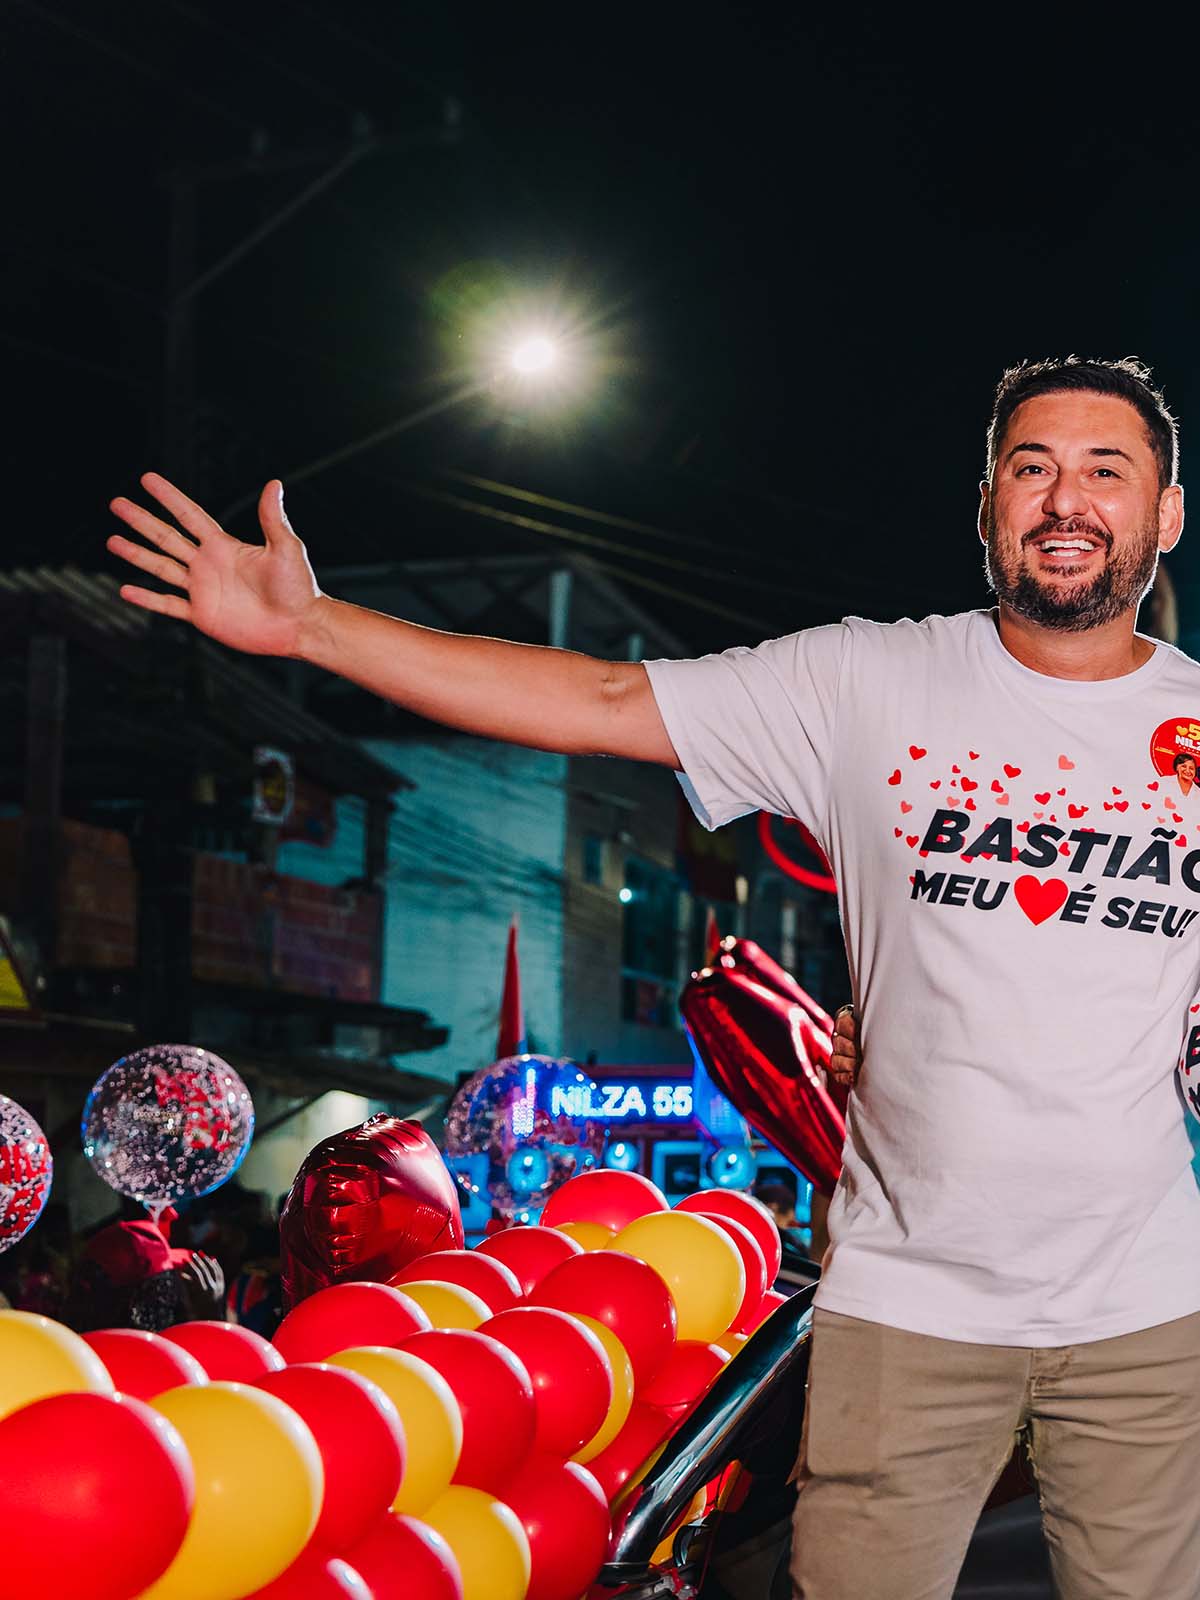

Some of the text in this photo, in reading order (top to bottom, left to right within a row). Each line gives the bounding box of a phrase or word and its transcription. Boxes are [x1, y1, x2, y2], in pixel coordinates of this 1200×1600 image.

[910, 869, 1200, 938] MEU É SEU!
[552, 1085, 693, 1117] NILZA 55
